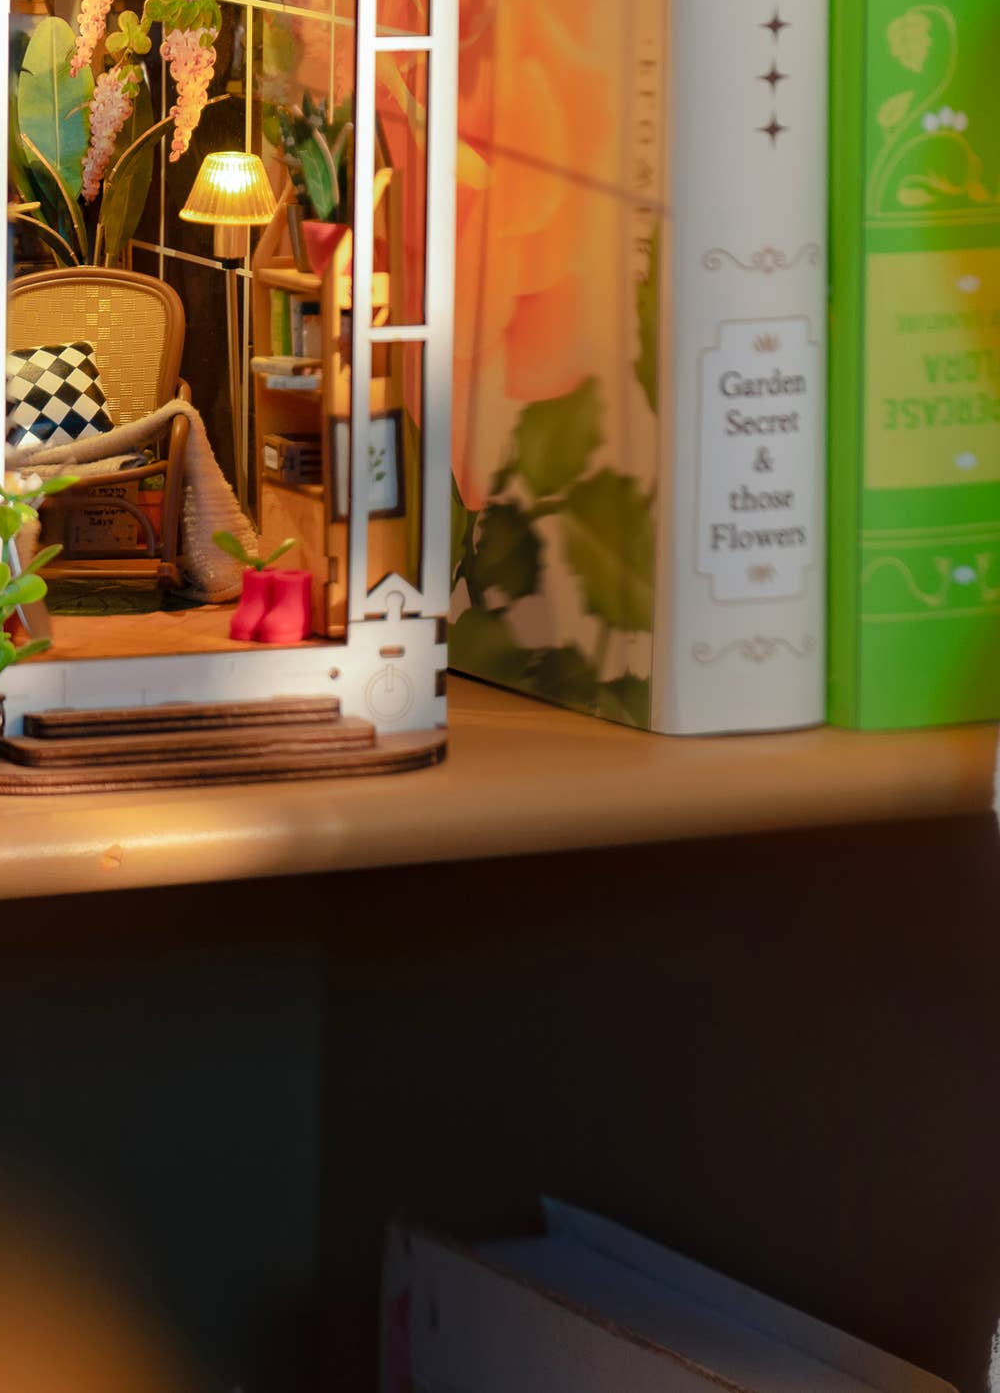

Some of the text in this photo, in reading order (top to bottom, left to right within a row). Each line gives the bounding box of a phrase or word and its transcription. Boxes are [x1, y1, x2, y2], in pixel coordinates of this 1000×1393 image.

[718, 369, 805, 399] Garden
[725, 409, 800, 438] Secret
[753, 446, 773, 473] &
[730, 486, 794, 513] those
[710, 523, 806, 551] Flowers
